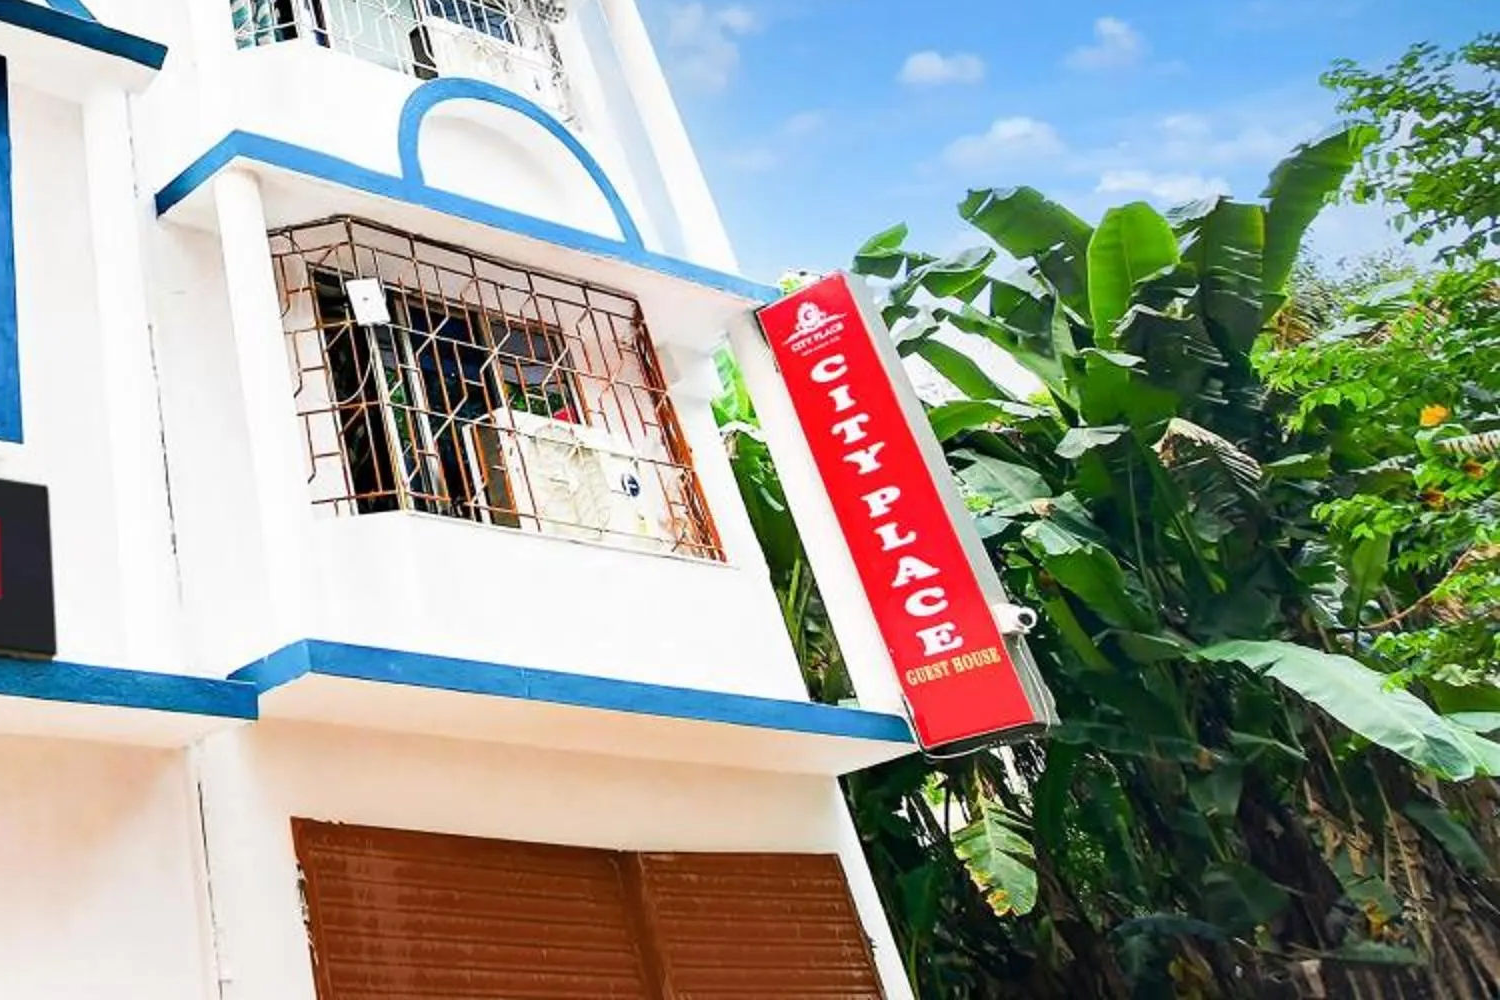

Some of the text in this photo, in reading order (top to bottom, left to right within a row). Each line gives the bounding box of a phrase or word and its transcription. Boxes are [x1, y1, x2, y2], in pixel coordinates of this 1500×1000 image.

[791, 336, 812, 353] CITY
[813, 321, 845, 343] PLACE
[810, 353, 886, 475] CITY
[860, 485, 964, 657] PLACE
[906, 647, 1001, 687] GUEST HOUSE
